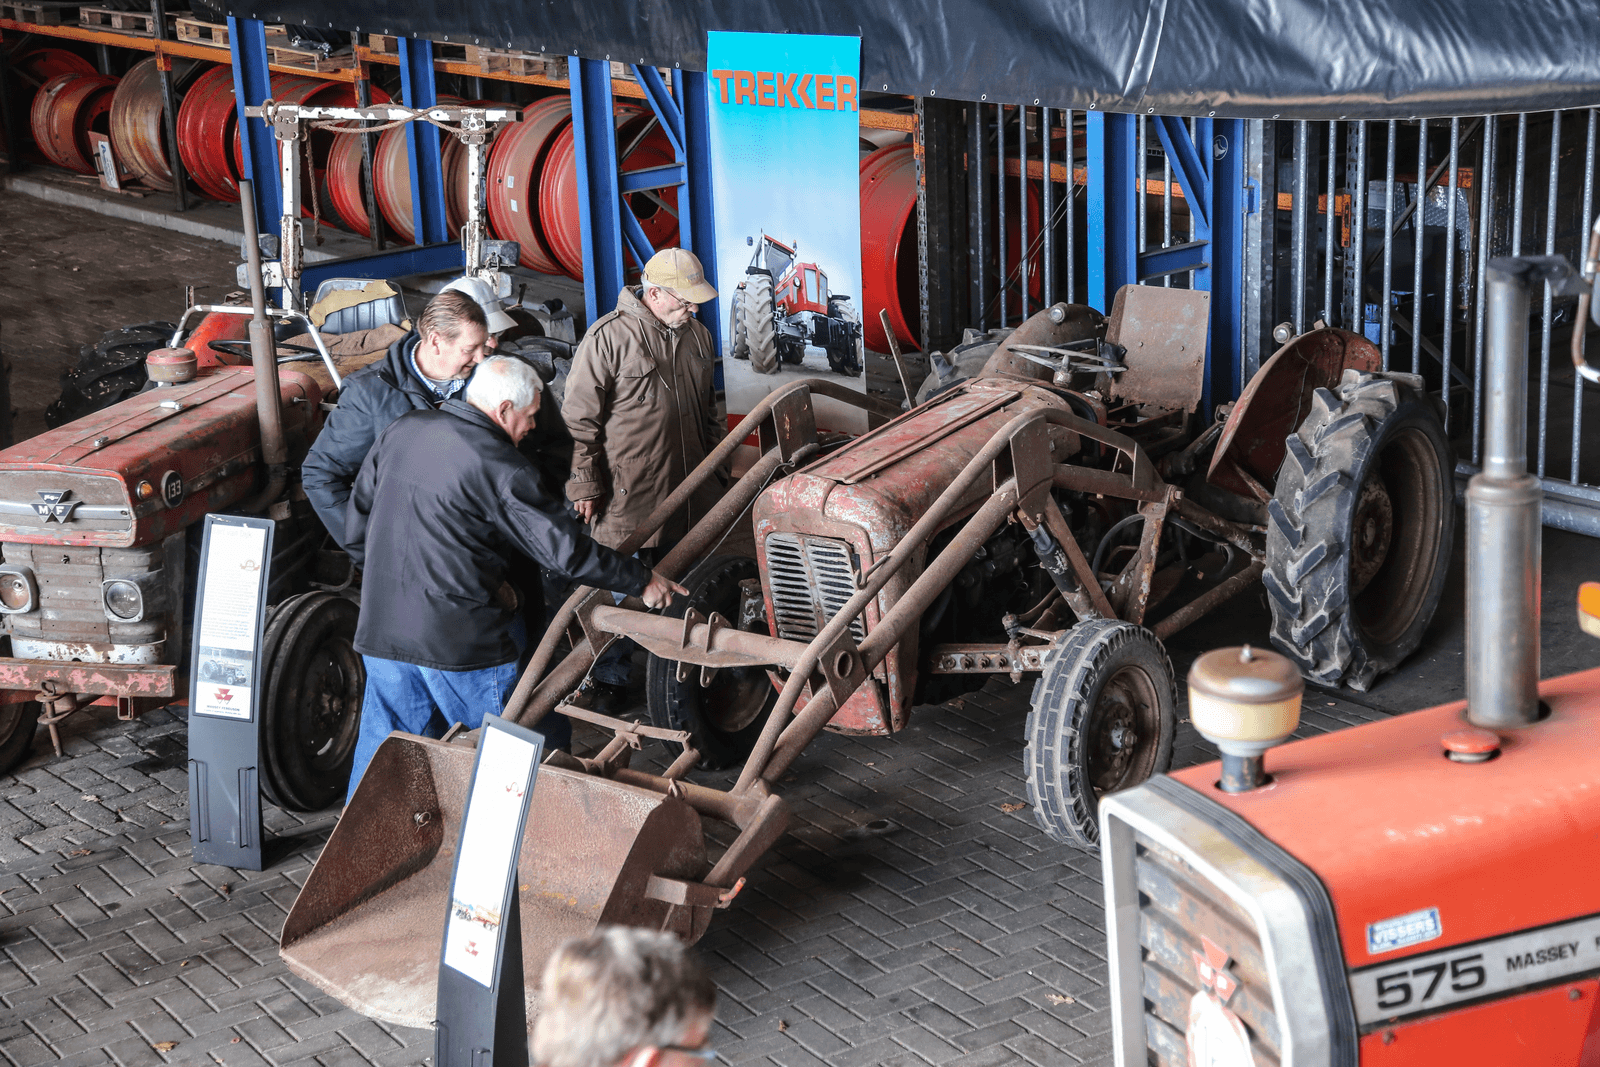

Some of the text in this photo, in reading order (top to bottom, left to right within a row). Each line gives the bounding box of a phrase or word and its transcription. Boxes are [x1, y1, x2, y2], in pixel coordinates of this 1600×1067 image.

[712, 69, 858, 112] TREKKER
[168, 479, 182, 500] 133
[1376, 941, 1580, 1010] 575 MASSEY
